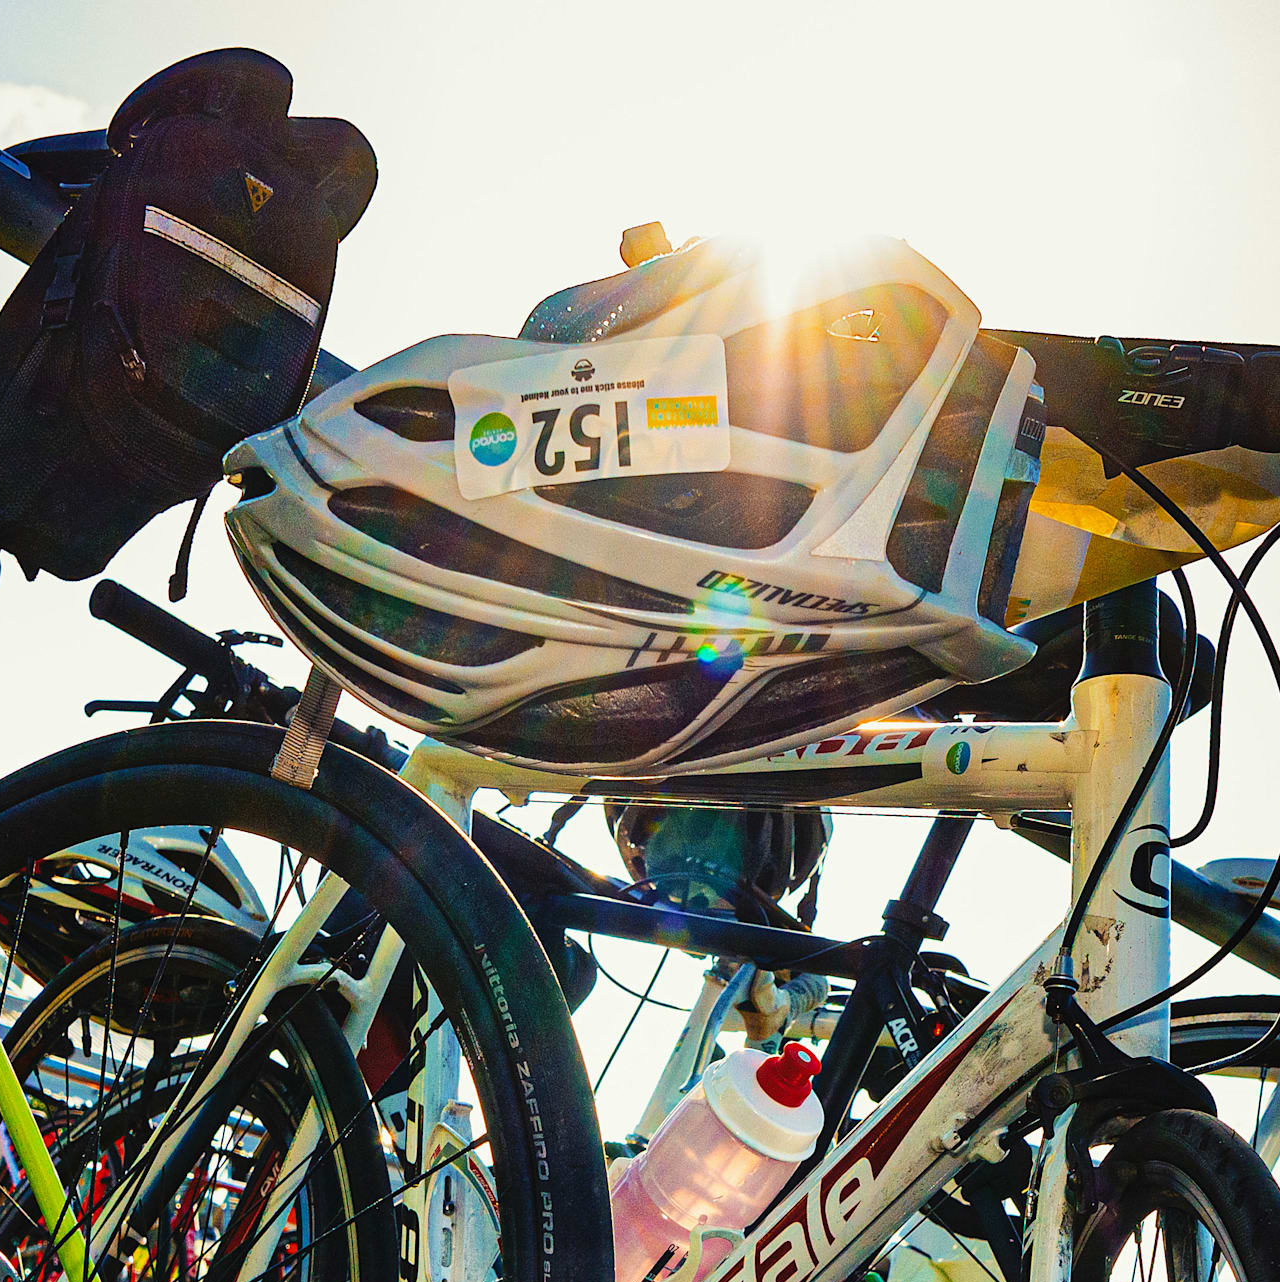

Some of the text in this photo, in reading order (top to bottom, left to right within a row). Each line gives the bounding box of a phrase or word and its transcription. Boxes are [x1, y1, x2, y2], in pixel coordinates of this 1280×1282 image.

[551, 387, 569, 398] your
[570, 386, 579, 396] to
[595, 382, 615, 393] stick
[616, 379, 645, 391] please
[1118, 389, 1186, 409] ZONE3
[471, 431, 515, 453] conrad
[531, 401, 631, 476] 152
[696, 569, 880, 616] SPECIALIZED
[888, 1017, 919, 1058] ACR
[480, 952, 520, 1050] Vittoria
[516, 1060, 551, 1181] ZAFFIRO
[540, 1191, 556, 1255] PRO
